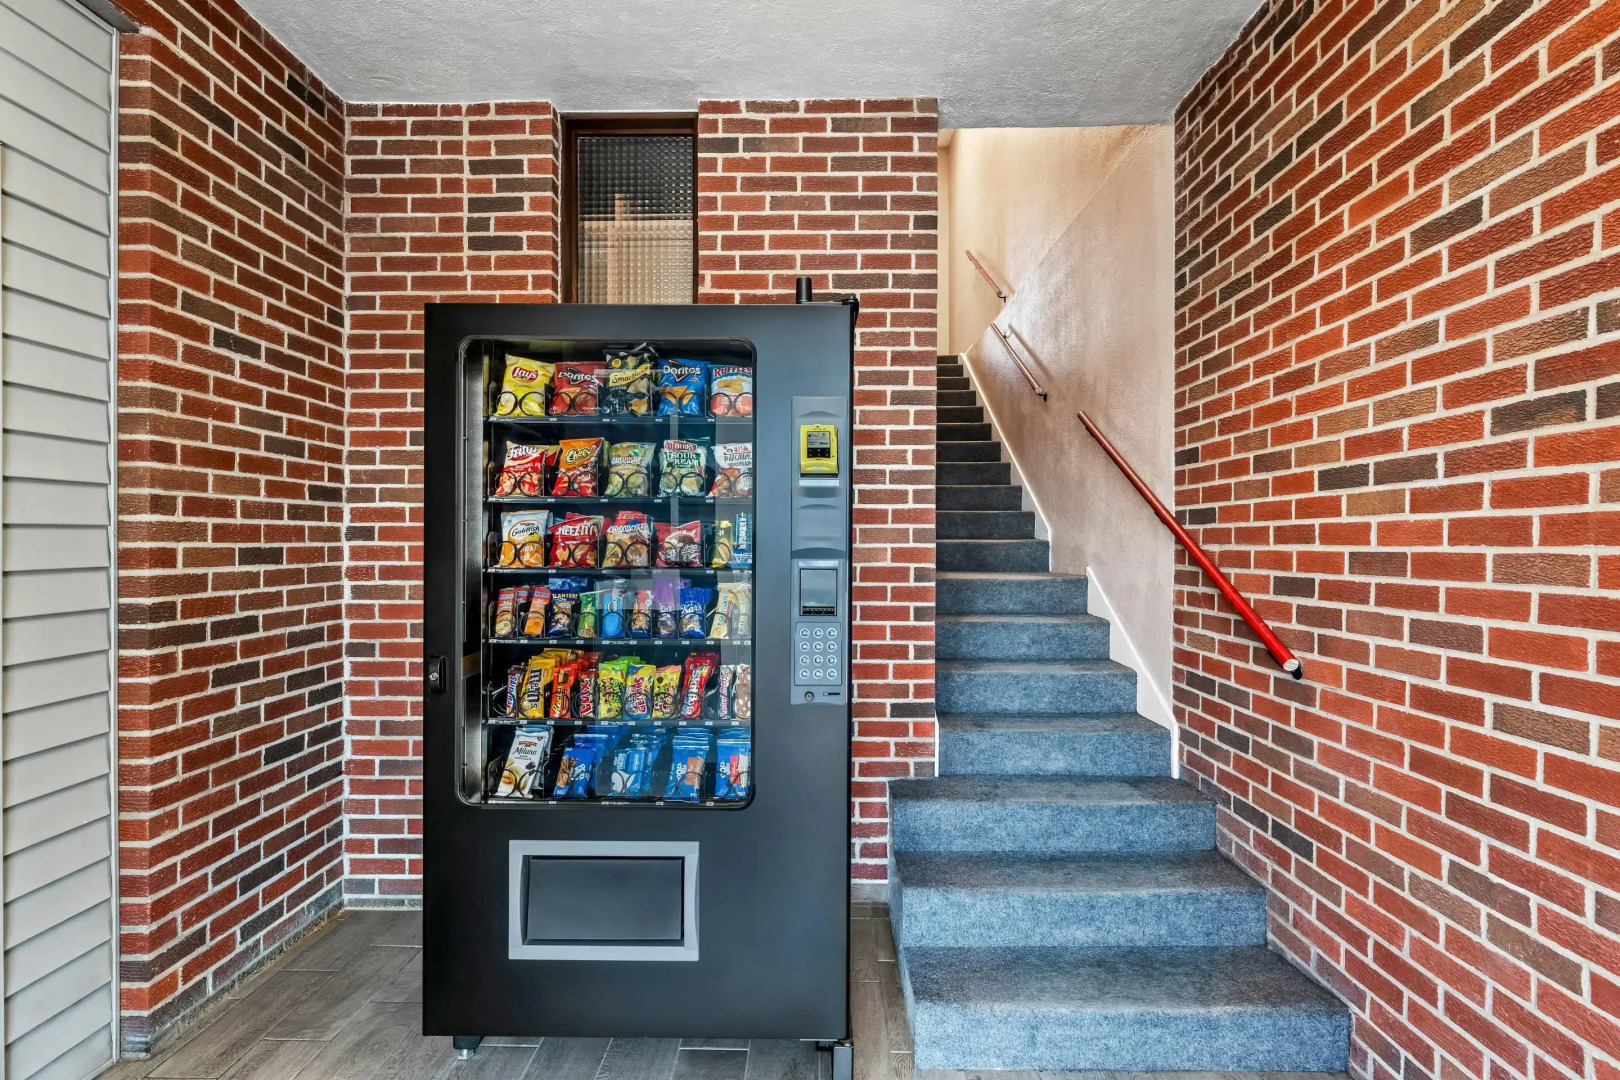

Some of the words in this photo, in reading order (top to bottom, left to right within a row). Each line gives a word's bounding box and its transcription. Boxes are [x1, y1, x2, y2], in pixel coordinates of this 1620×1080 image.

[512, 366, 538, 380] Lay's
[663, 365, 702, 375] Doritos
[713, 366, 753, 378] RUFFLES
[558, 371, 598, 383] Doritos
[671, 452, 697, 460] SOUR
[511, 525, 541, 537] Goldfish
[580, 681, 592, 717] TWIX
[511, 746, 537, 756] Milano
